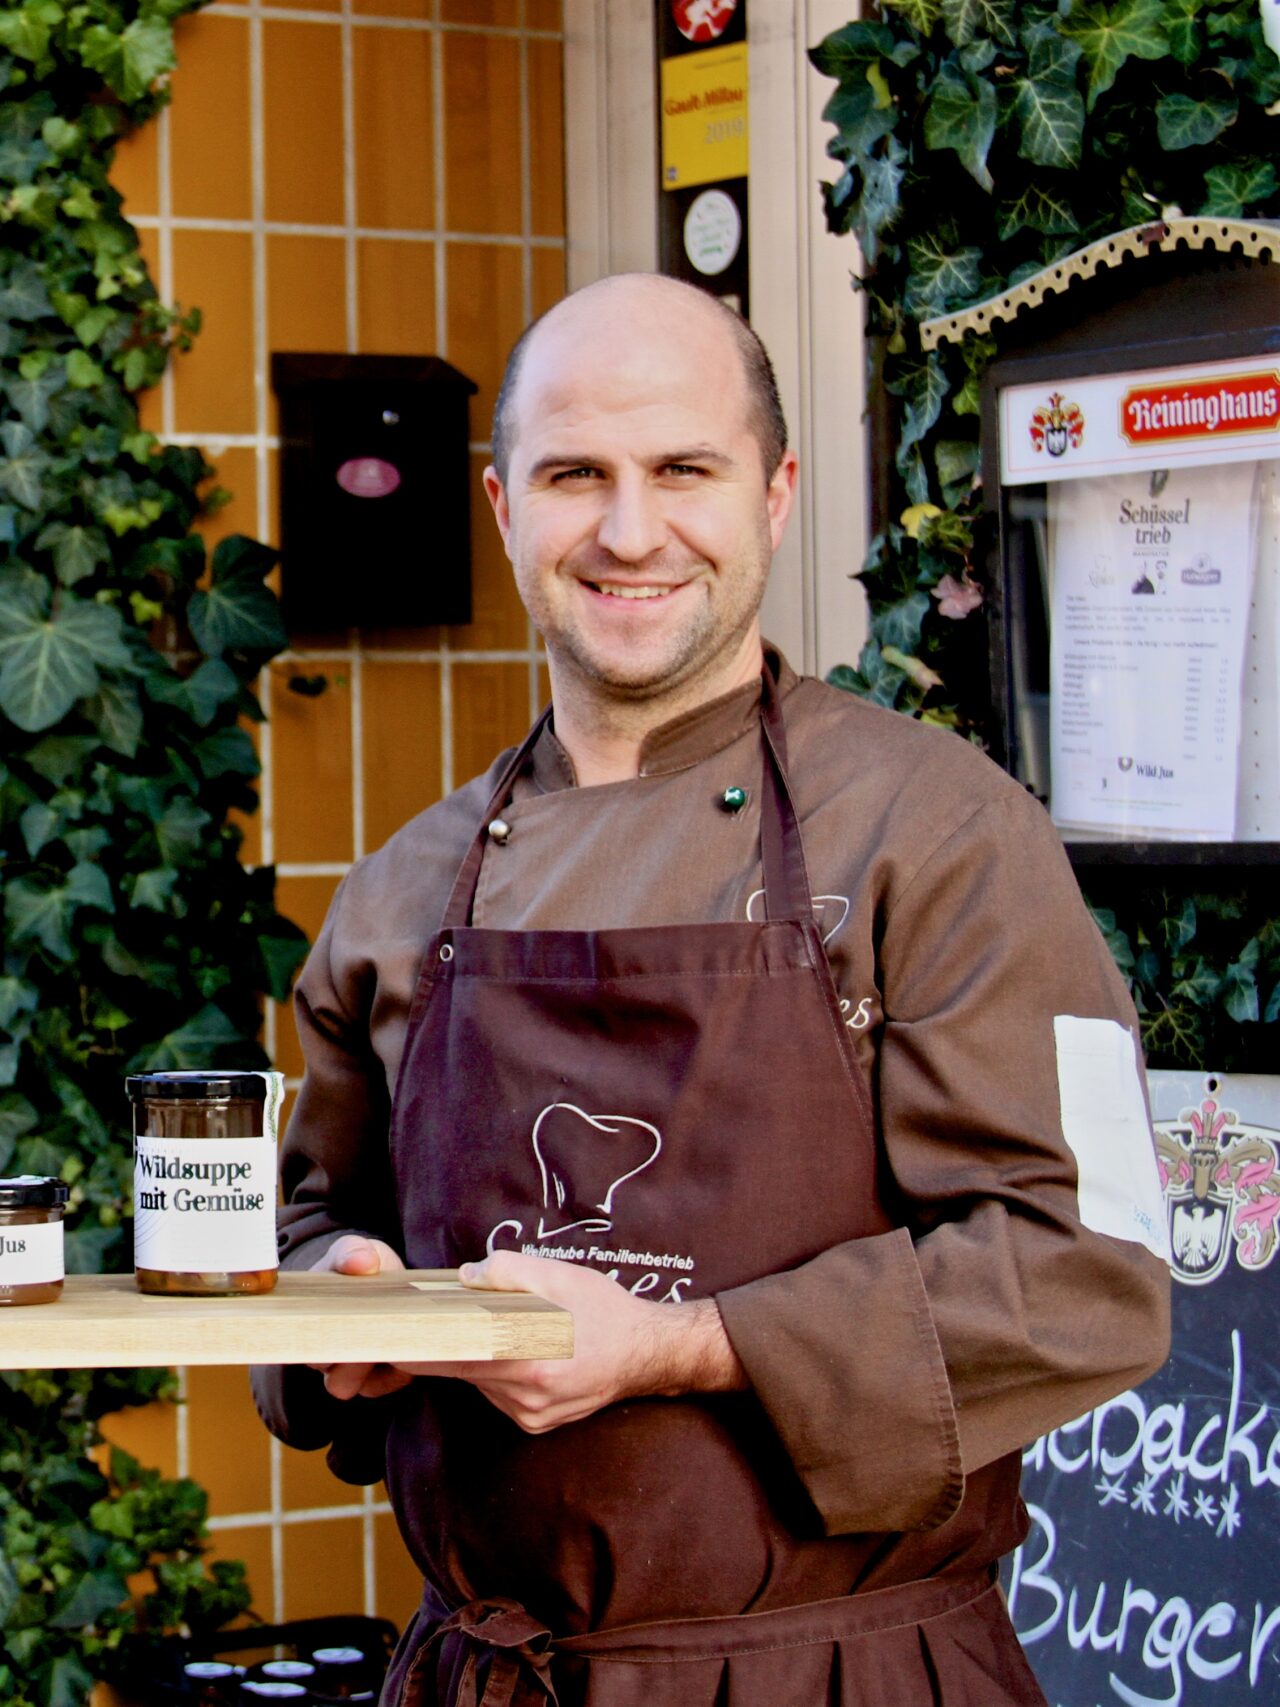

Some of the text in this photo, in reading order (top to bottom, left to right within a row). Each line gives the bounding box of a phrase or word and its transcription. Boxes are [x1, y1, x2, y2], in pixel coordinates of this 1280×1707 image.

[1128, 388, 1278, 431] Reininghaus
[1119, 498, 1191, 525] Schüssel
[1136, 525, 1171, 545] trieb
[1136, 763, 1174, 780] Wild Jus
[139, 1153, 252, 1186] Wildsuppe
[140, 1186, 264, 1212] mit Gemüse
[521, 1243, 695, 1271] Weinstube Familienbetrieb
